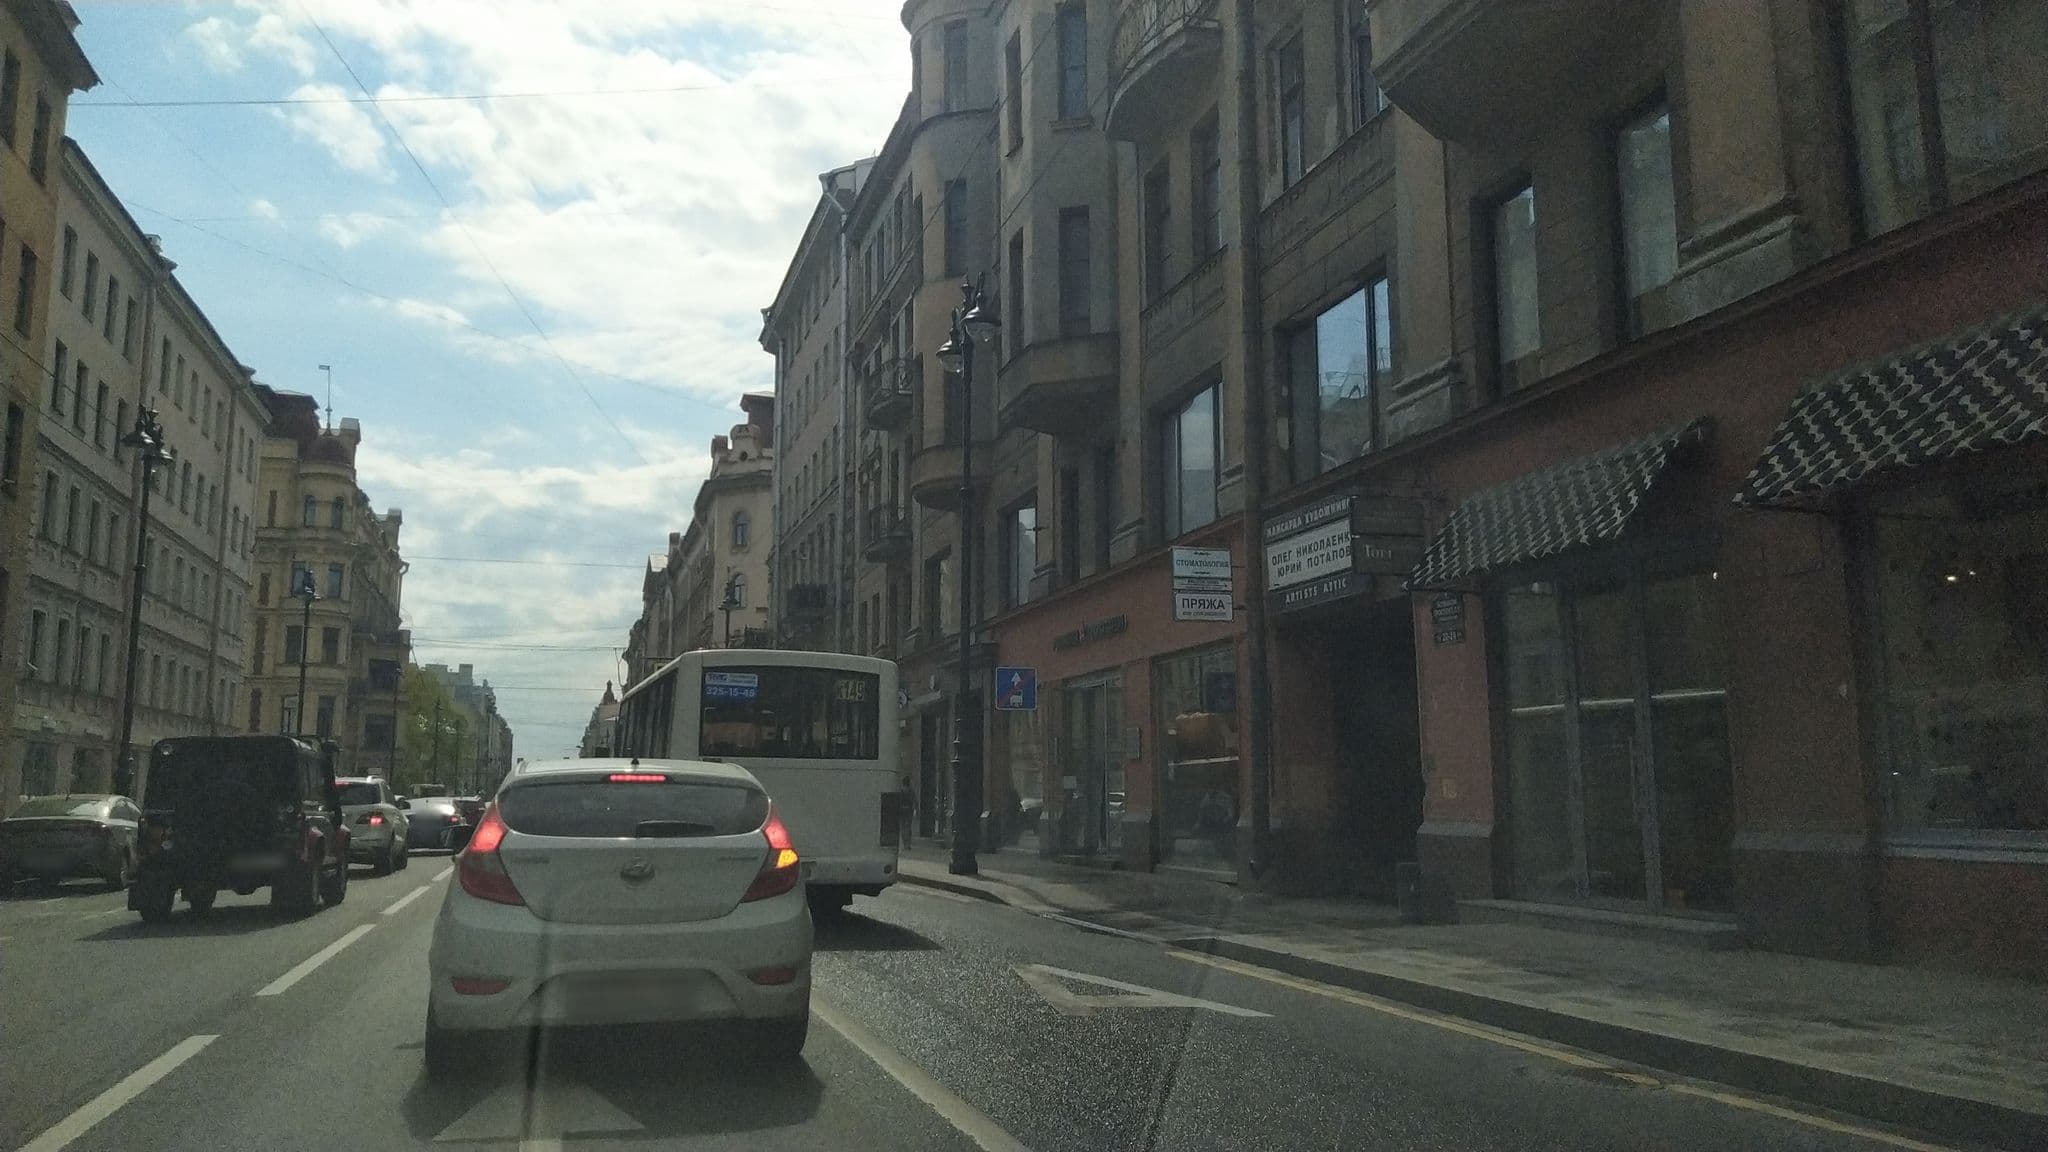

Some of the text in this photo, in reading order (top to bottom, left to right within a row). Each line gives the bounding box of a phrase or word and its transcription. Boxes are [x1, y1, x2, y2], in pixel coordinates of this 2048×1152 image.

[1271, 530, 1351, 566] ОЛЕГ НИКОЛАЕНК
[1175, 559, 1229, 568] СТОМАТОЛОГИЯ
[1277, 545, 1351, 578] ЮРИЙ ПОТАПОВ
[1323, 577, 1346, 593] ATTIC
[1182, 598, 1225, 610] ПРЯЖА
